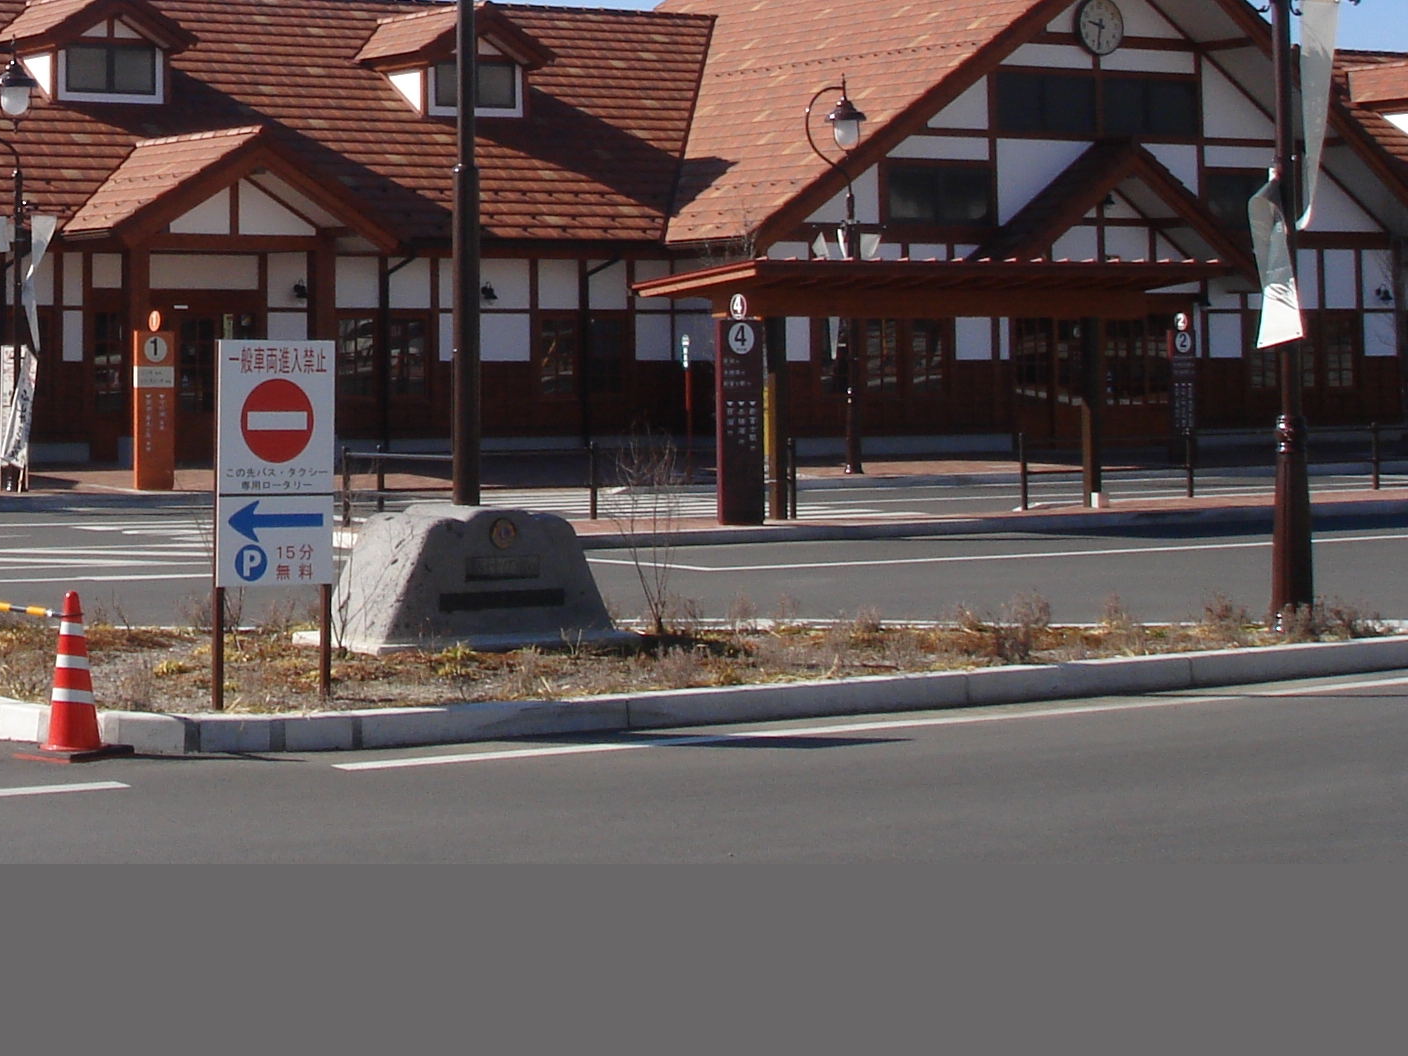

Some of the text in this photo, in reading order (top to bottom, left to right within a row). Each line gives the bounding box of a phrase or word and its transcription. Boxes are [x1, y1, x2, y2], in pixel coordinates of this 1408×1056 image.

[733, 296, 743, 314] 4
[734, 325, 747, 346] 4
[1179, 333, 1187, 348] 2
[150, 338, 158, 356] 1
[228, 347, 328, 374] 一般車両進入禁止
[226, 466, 329, 479] この先バス・タクシー
[240, 479, 313, 492] 専用ロータリー
[276, 544, 314, 561] 15分
[276, 563, 314, 581] 無料
